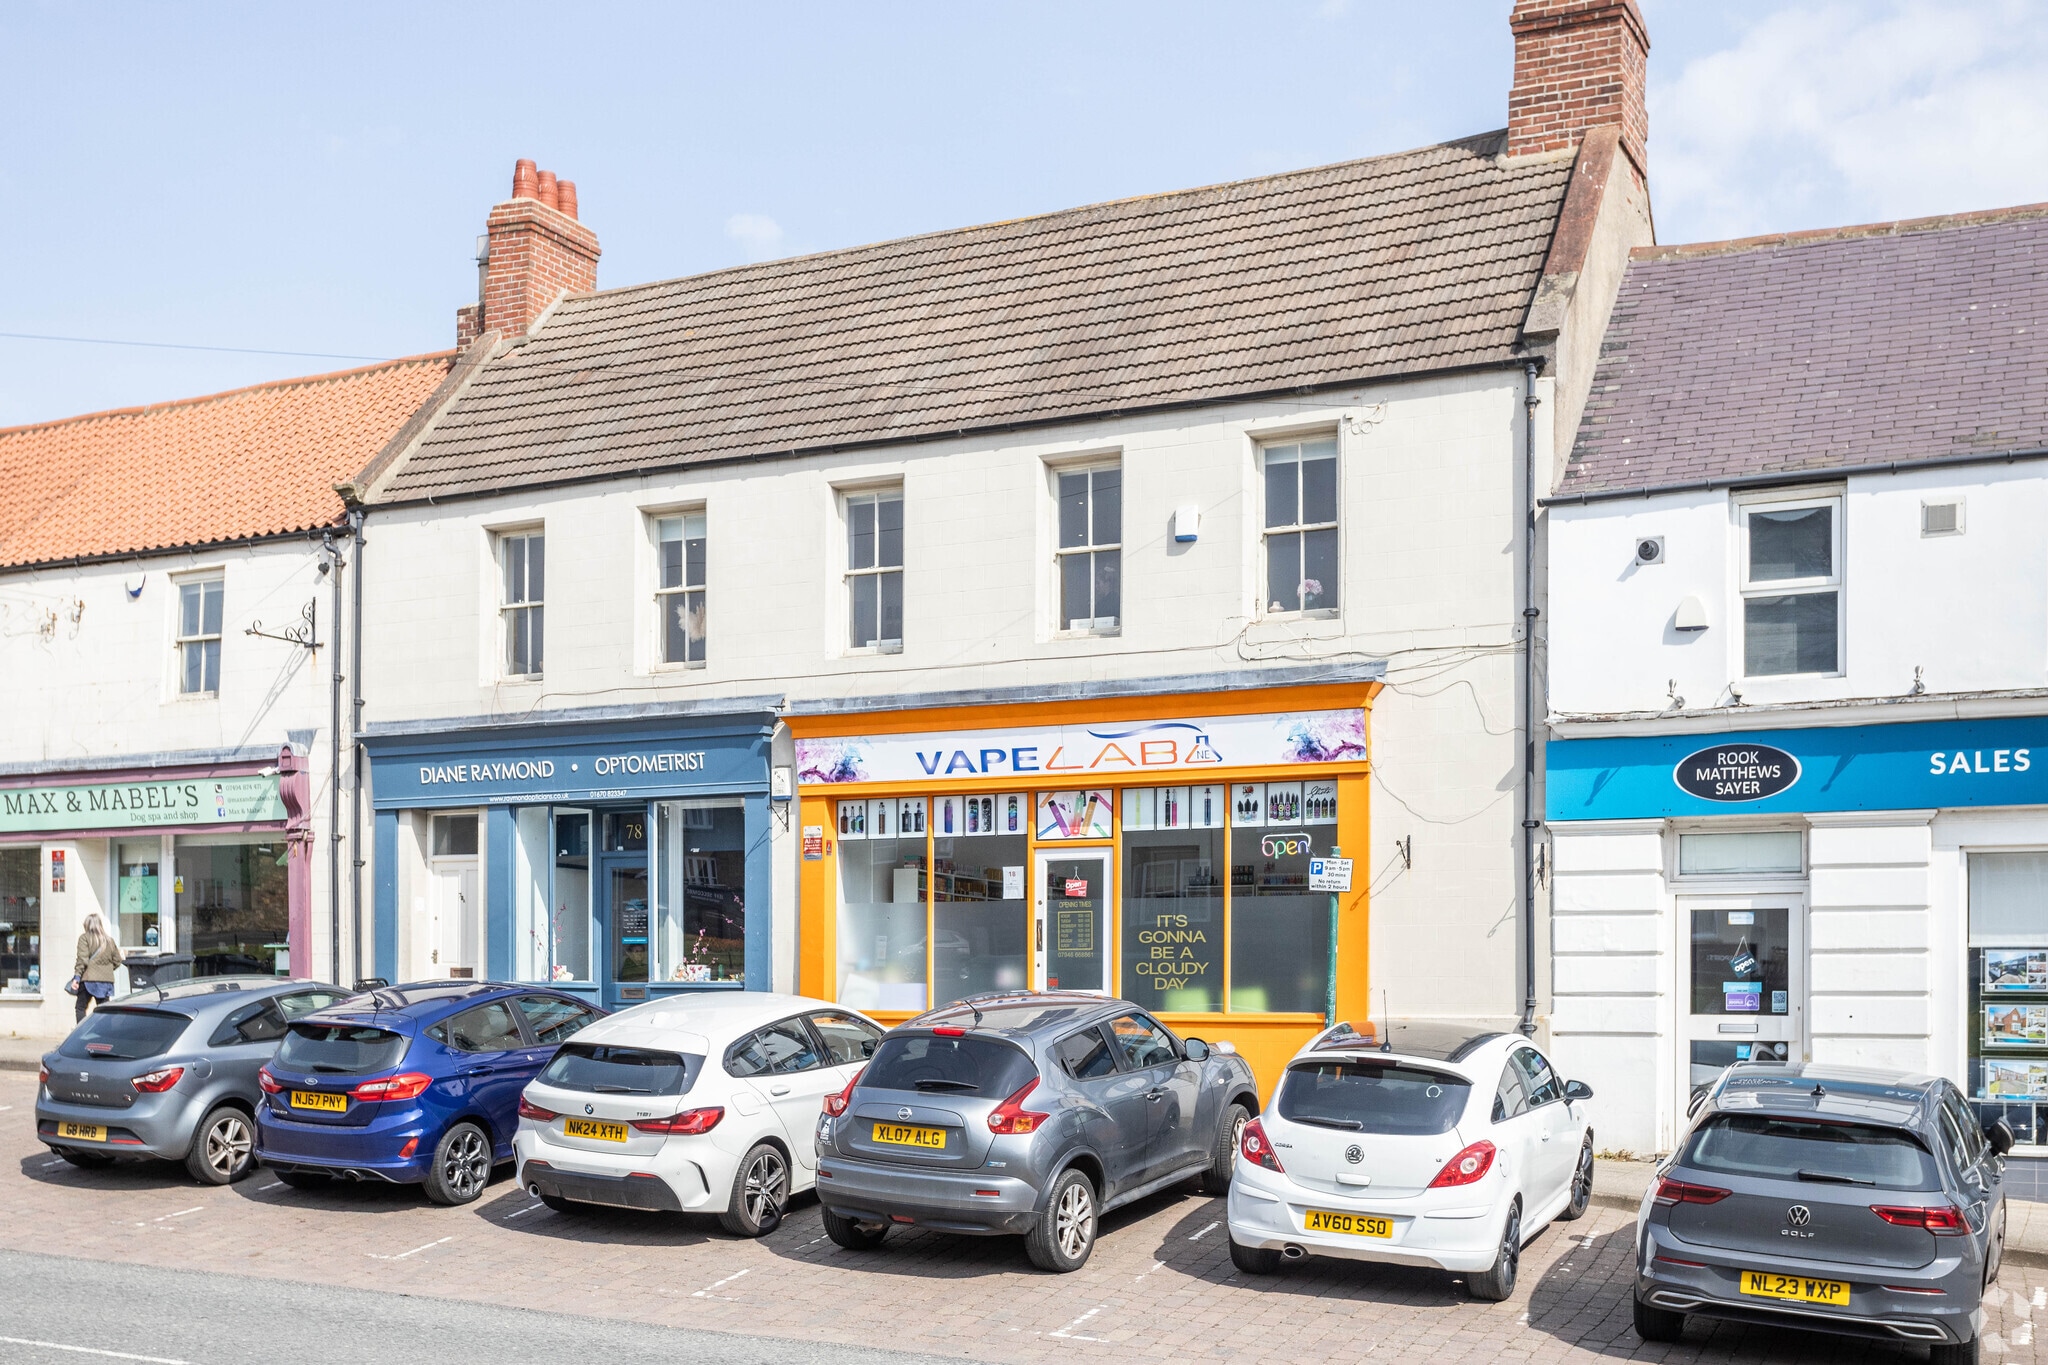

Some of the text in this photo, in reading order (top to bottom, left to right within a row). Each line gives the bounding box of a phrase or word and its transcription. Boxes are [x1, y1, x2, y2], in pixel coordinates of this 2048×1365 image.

[1196, 749, 1210, 760] NE
[1717, 751, 1759, 766] ROOK
[1929, 748, 2031, 775] SALES
[420, 752, 706, 784] DIANE RAYMOND OPTOMETRIST
[1695, 765, 1781, 781] MATTHEWS
[589, 790, 607, 798] 01670
[607, 789, 627, 798] 823347
[1715, 780, 1760, 795] SAYER
[4, 785, 199, 815] MAX & MABEL'S
[130, 810, 199, 822] Dog spa and shop
[625, 824, 642, 839] 78
[1262, 840, 1309, 859] open
[1156, 914, 1188, 928] IT'S
[1138, 930, 1206, 943] GONNA
[1150, 946, 1193, 960] BE A
[1135, 961, 1210, 975] CLOUDY
[1734, 957, 1755, 972] open
[1154, 977, 1189, 990] DAY
[295, 1092, 342, 1108] NJ67 PNY
[66, 1123, 97, 1138] G8 HRB
[568, 1121, 623, 1139] NK24 XTH
[878, 1126, 940, 1145] XL07 ALG
[1312, 1213, 1351, 1230] AV60
[1781, 1229, 1815, 1238] GOLF
[1750, 1273, 1841, 1300] NL23 WXP
